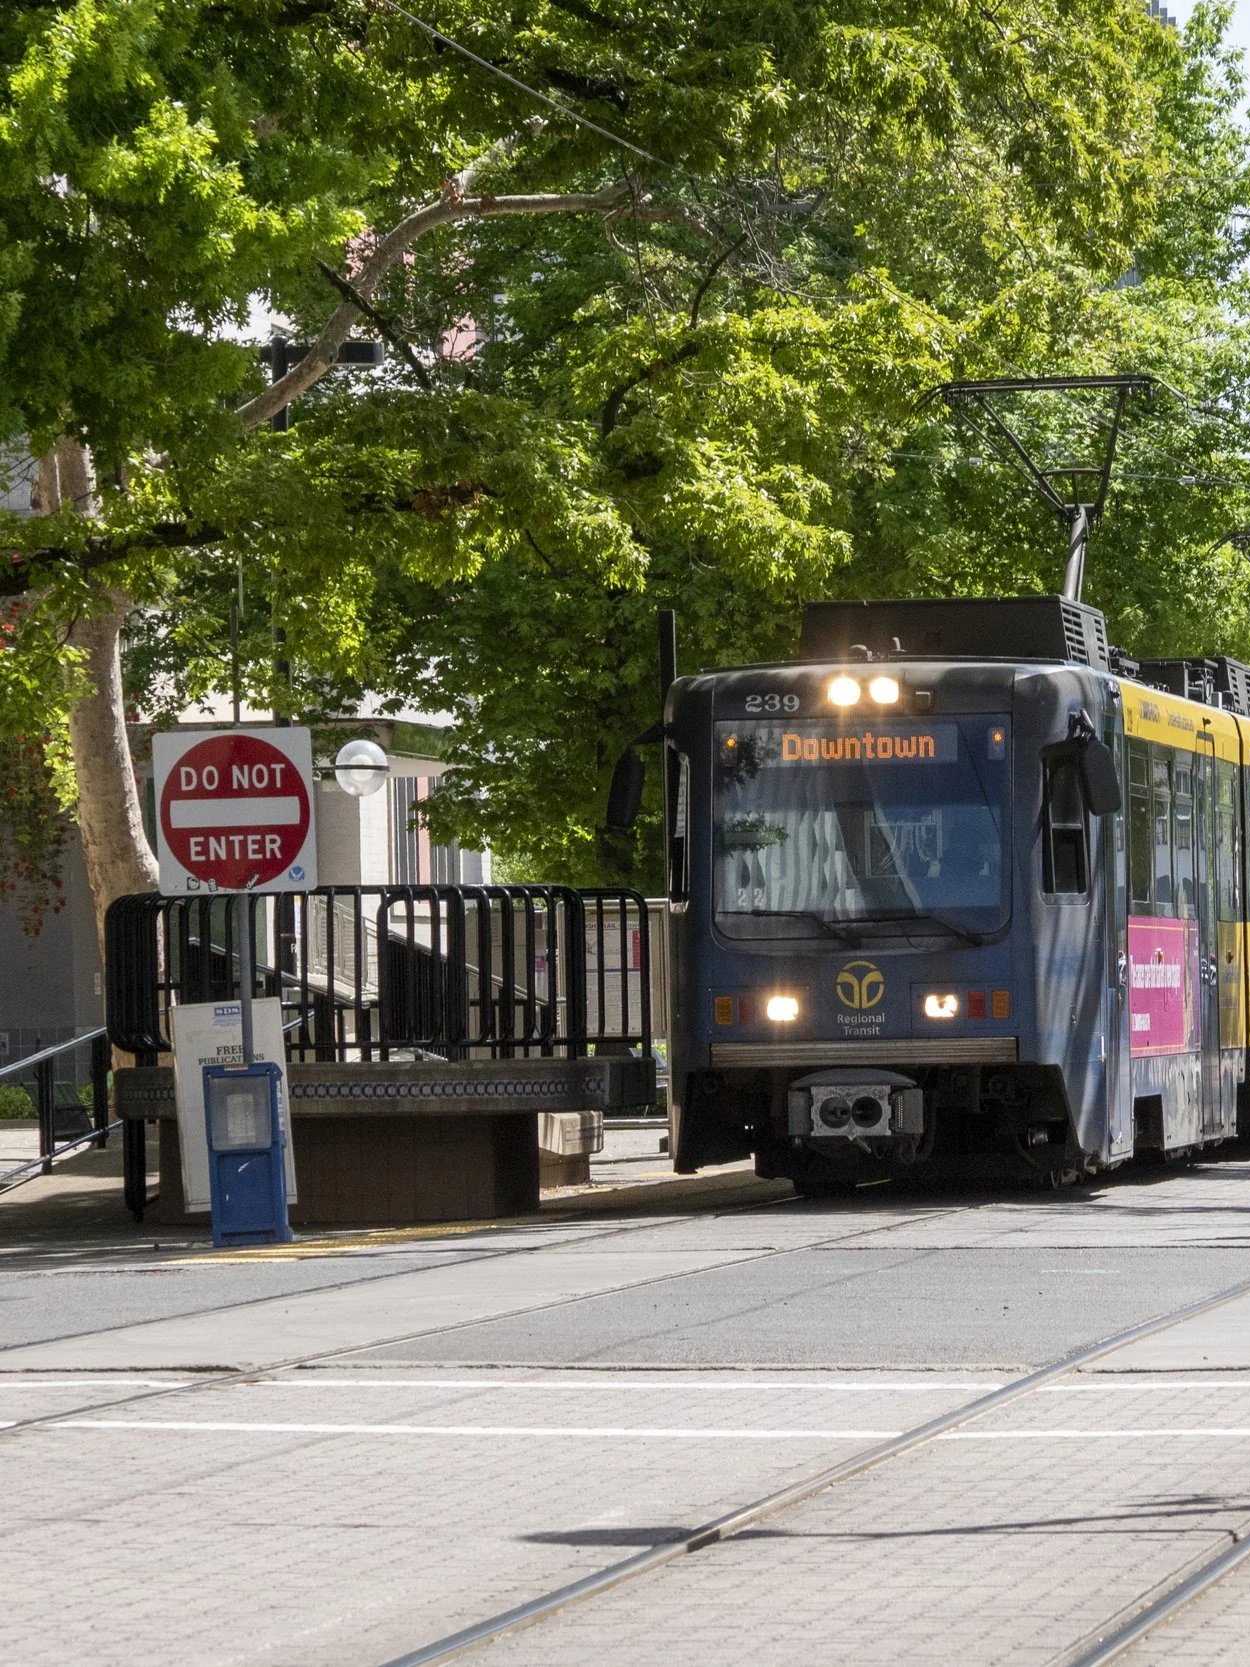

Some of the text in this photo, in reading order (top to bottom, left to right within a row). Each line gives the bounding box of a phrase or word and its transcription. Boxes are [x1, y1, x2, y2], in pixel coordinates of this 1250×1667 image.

[745, 693, 800, 712] 239
[782, 732, 935, 760] Downtown
[180, 763, 285, 791] DO NOT
[189, 834, 282, 861] ENTER
[837, 1013, 885, 1025] Regional
[843, 1025, 880, 1035] Transit
[198, 1053, 265, 1065] PUBLICATNS
